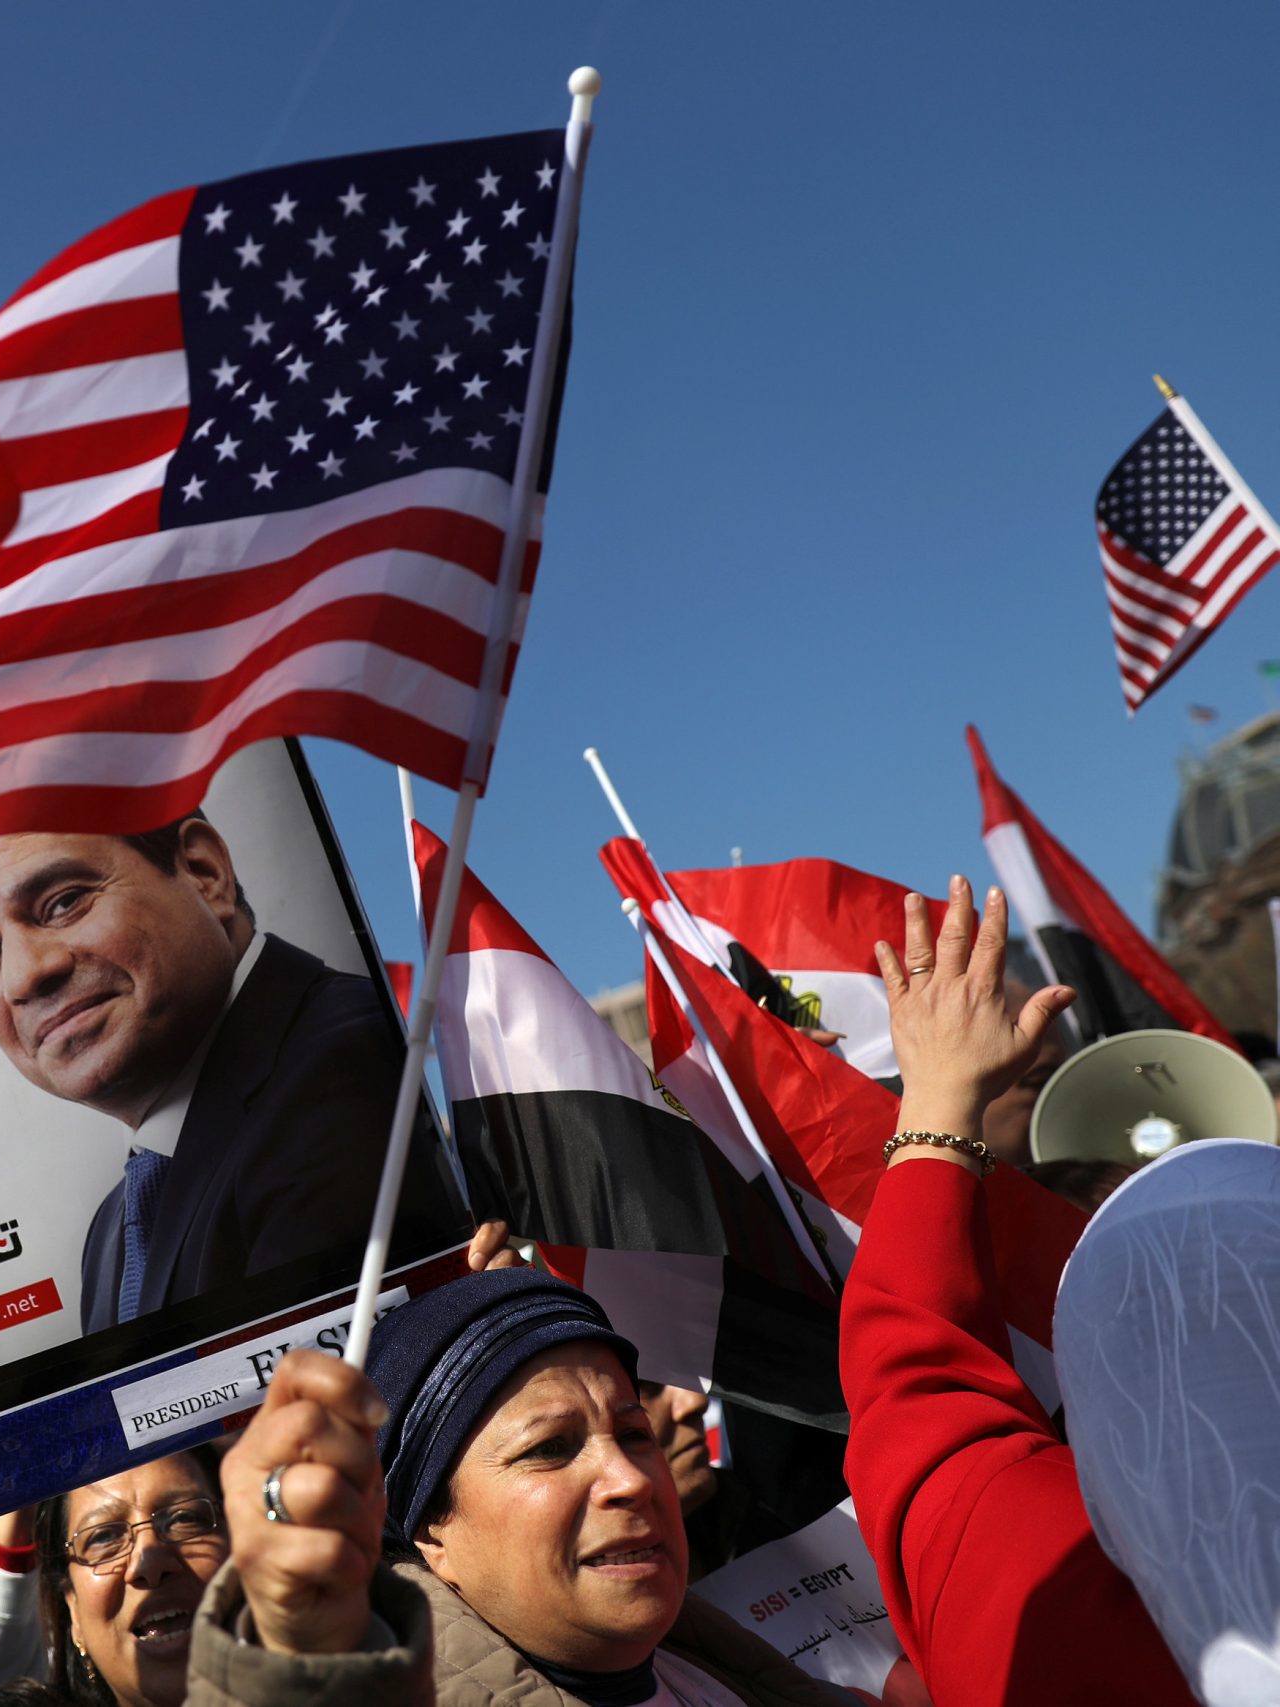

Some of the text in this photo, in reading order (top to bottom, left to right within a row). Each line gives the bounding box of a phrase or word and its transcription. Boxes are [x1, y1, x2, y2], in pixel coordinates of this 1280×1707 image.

[131, 1382, 240, 1433] PRESIDENT
[750, 1590, 790, 1623] SISI
[800, 1563, 855, 1595] EGYPT
